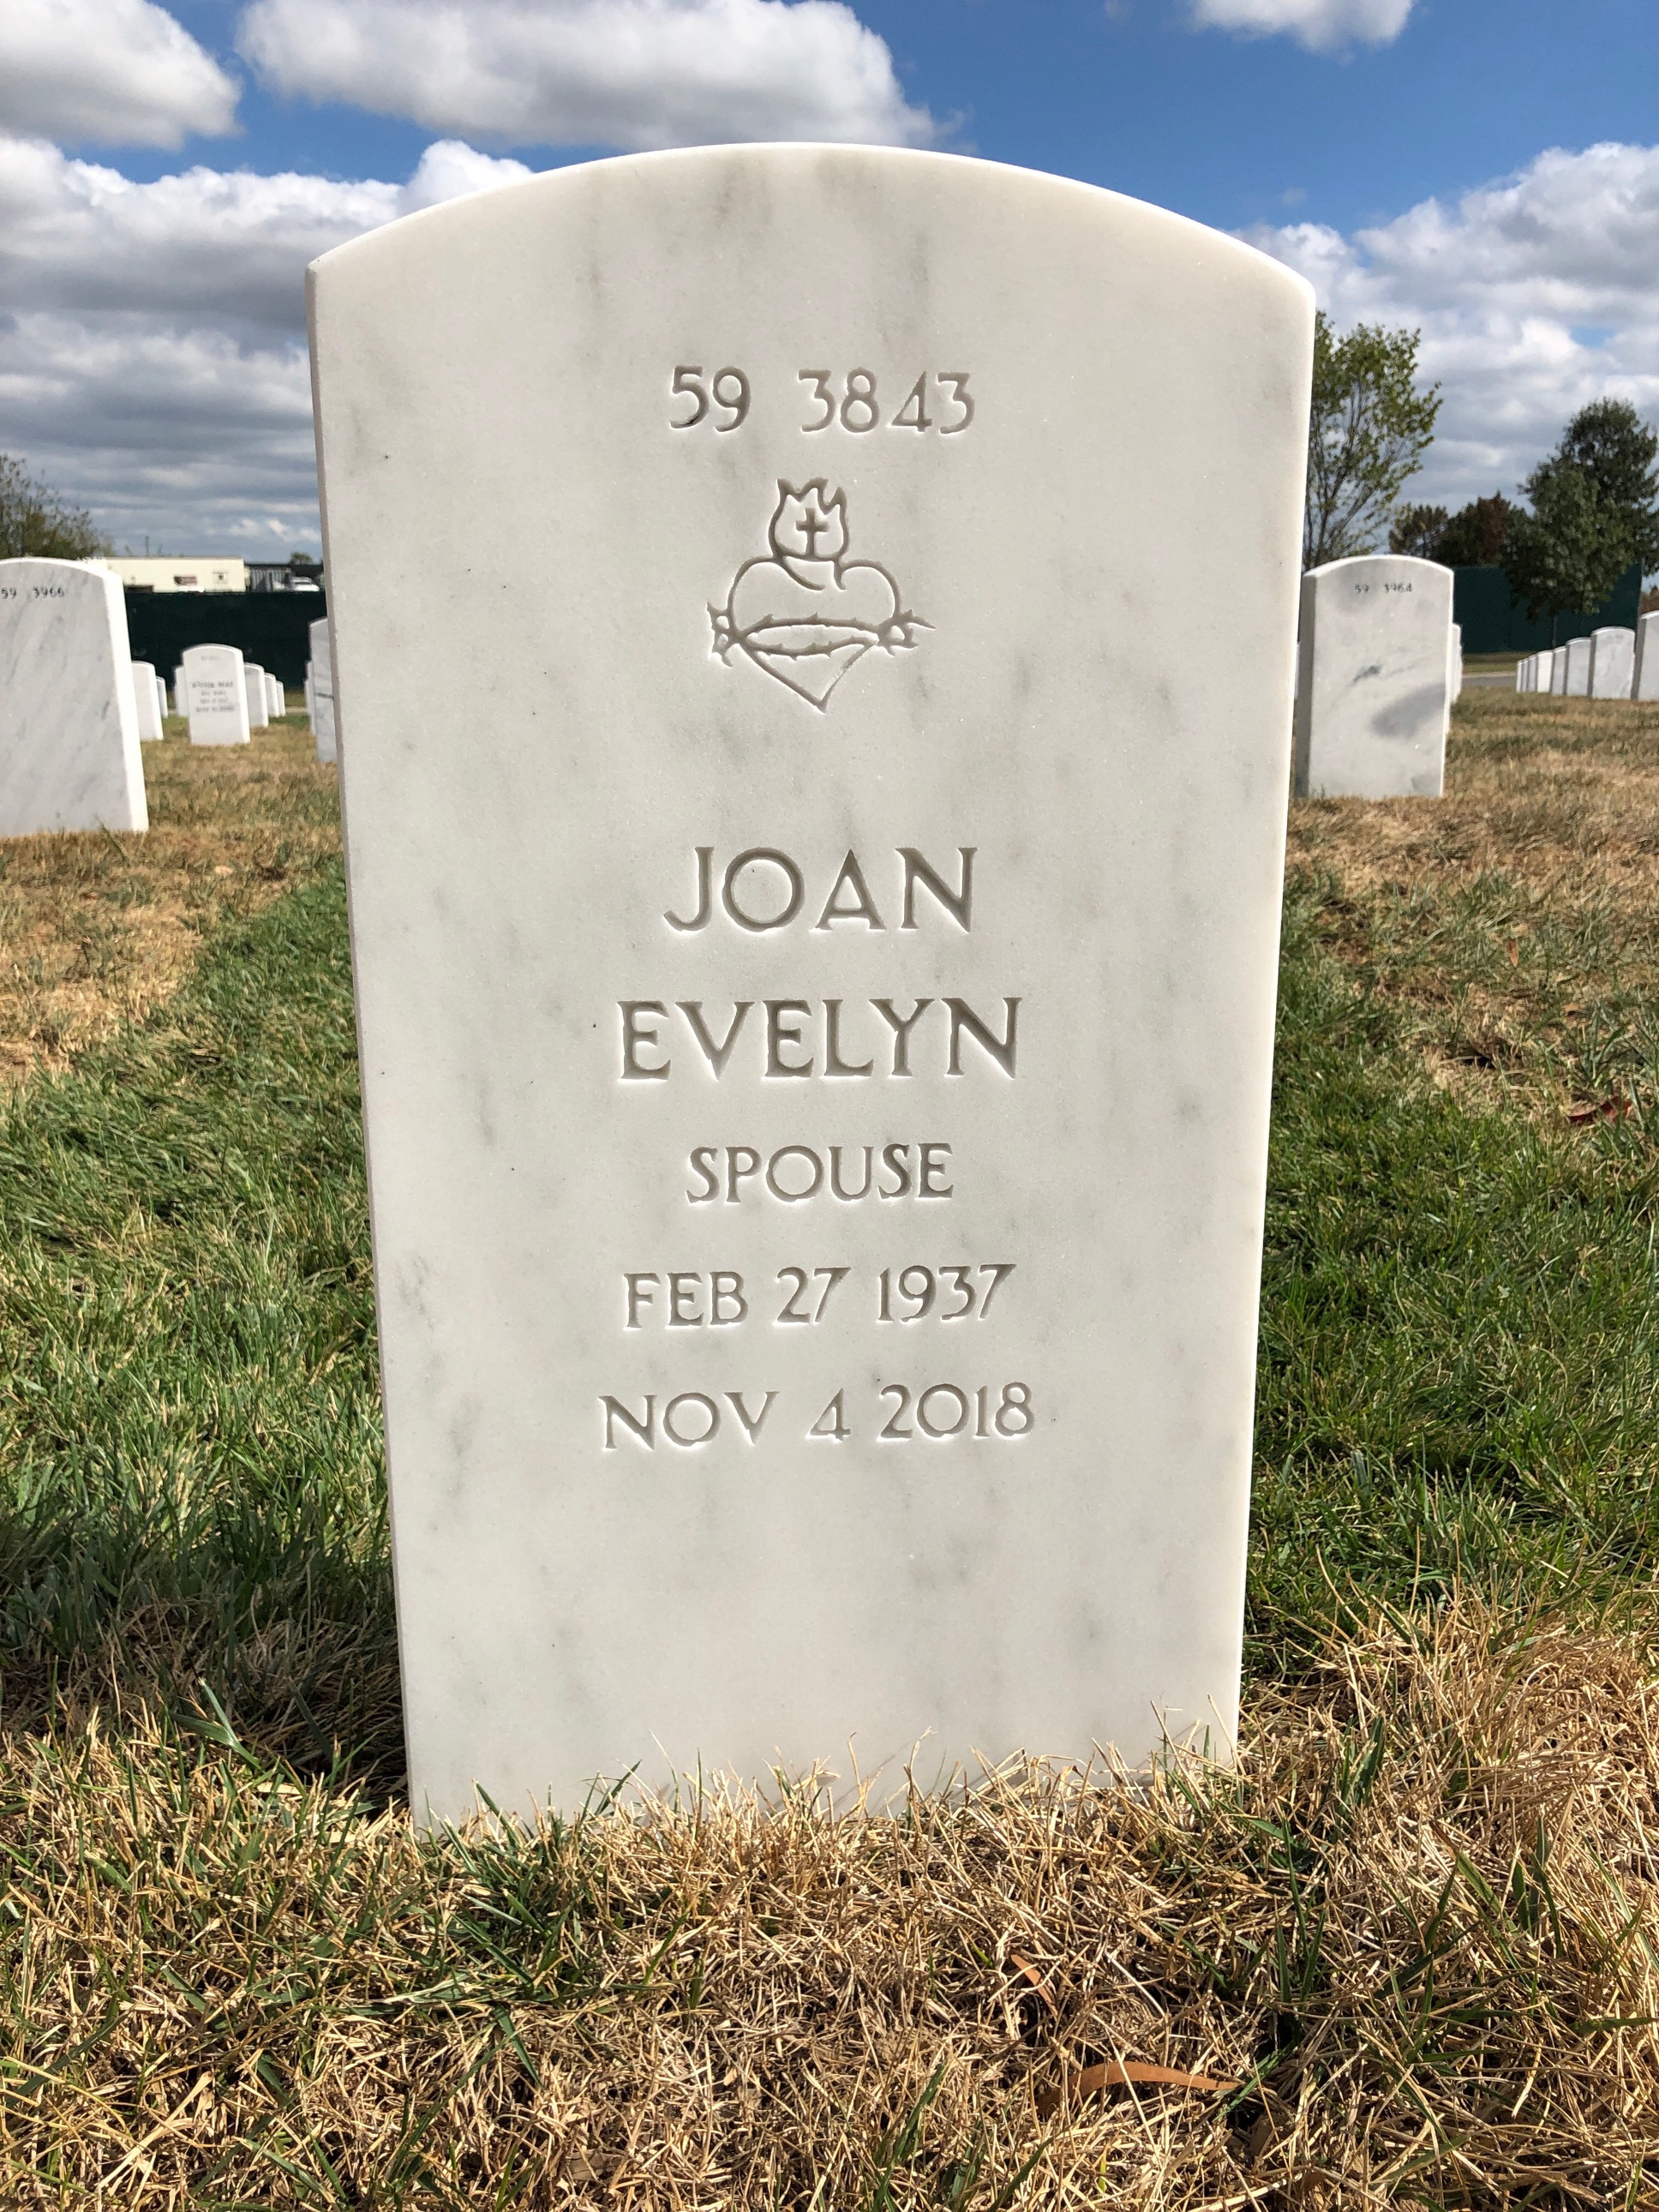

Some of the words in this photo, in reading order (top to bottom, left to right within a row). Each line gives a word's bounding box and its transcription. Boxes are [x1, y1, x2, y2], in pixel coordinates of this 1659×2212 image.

[669, 366, 751, 433] 59
[797, 368, 975, 435] 3843
[1, 586, 17, 599] 59
[1354, 583, 1369, 594] 59
[662, 846, 979, 934] JOAN
[615, 997, 1023, 1082] EVELYN
[686, 1142, 955, 1204] SPOUSE
[622, 1271, 749, 1330] FEB
[772, 1267, 852, 1325] 27
[876, 1263, 1018, 1324] 1937
[597, 1391, 781, 1450] NOV
[806, 1388, 852, 1442] 4
[876, 1382, 1036, 1442] 2018
